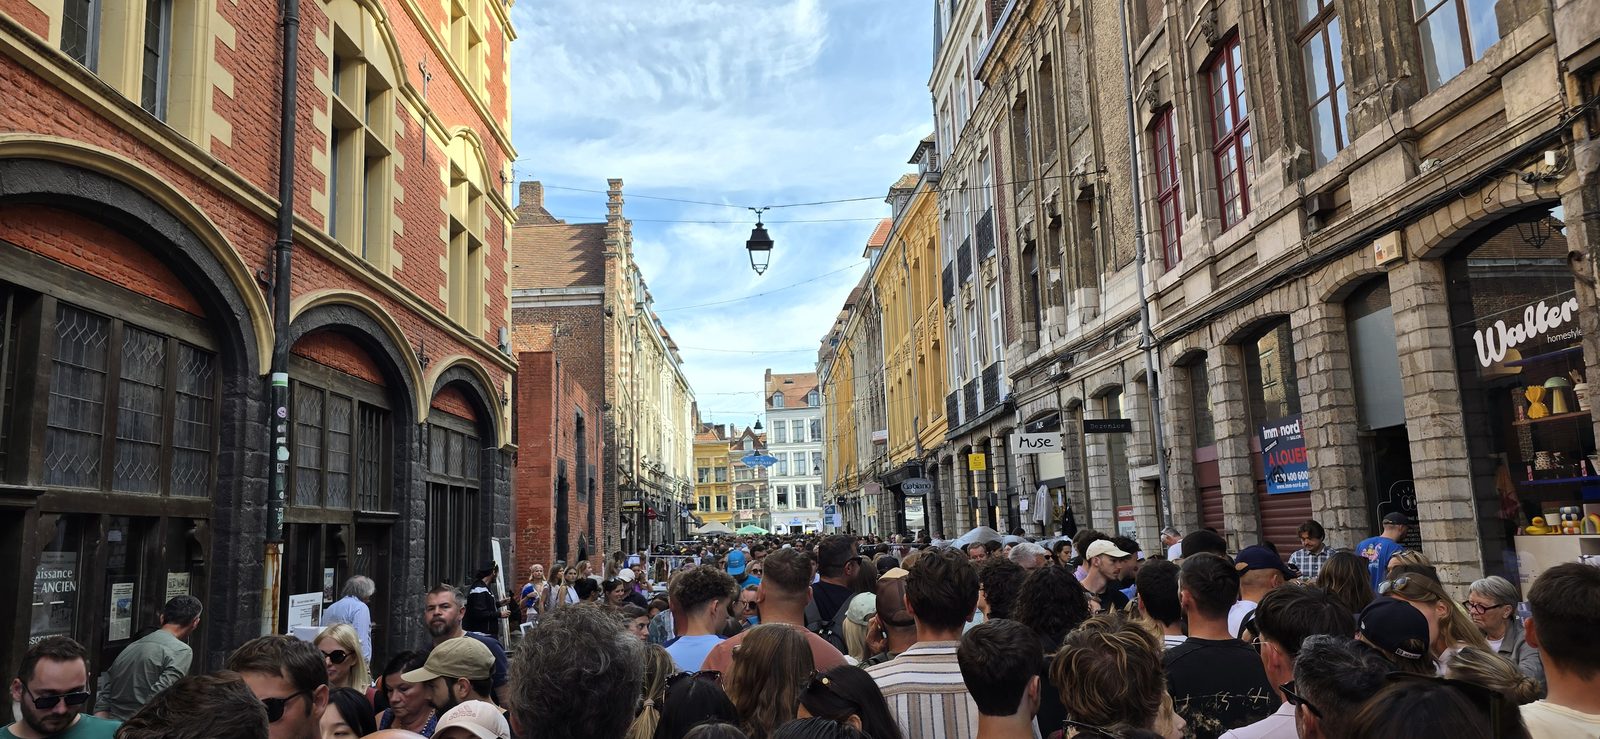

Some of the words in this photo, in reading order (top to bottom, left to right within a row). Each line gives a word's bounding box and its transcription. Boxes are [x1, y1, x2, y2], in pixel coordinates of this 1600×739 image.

[1473, 297, 1579, 368] Walter
[1019, 436, 1054, 448] Muse
[1270, 452, 1275, 465] A
[41, 581, 77, 593] ANCIEN
